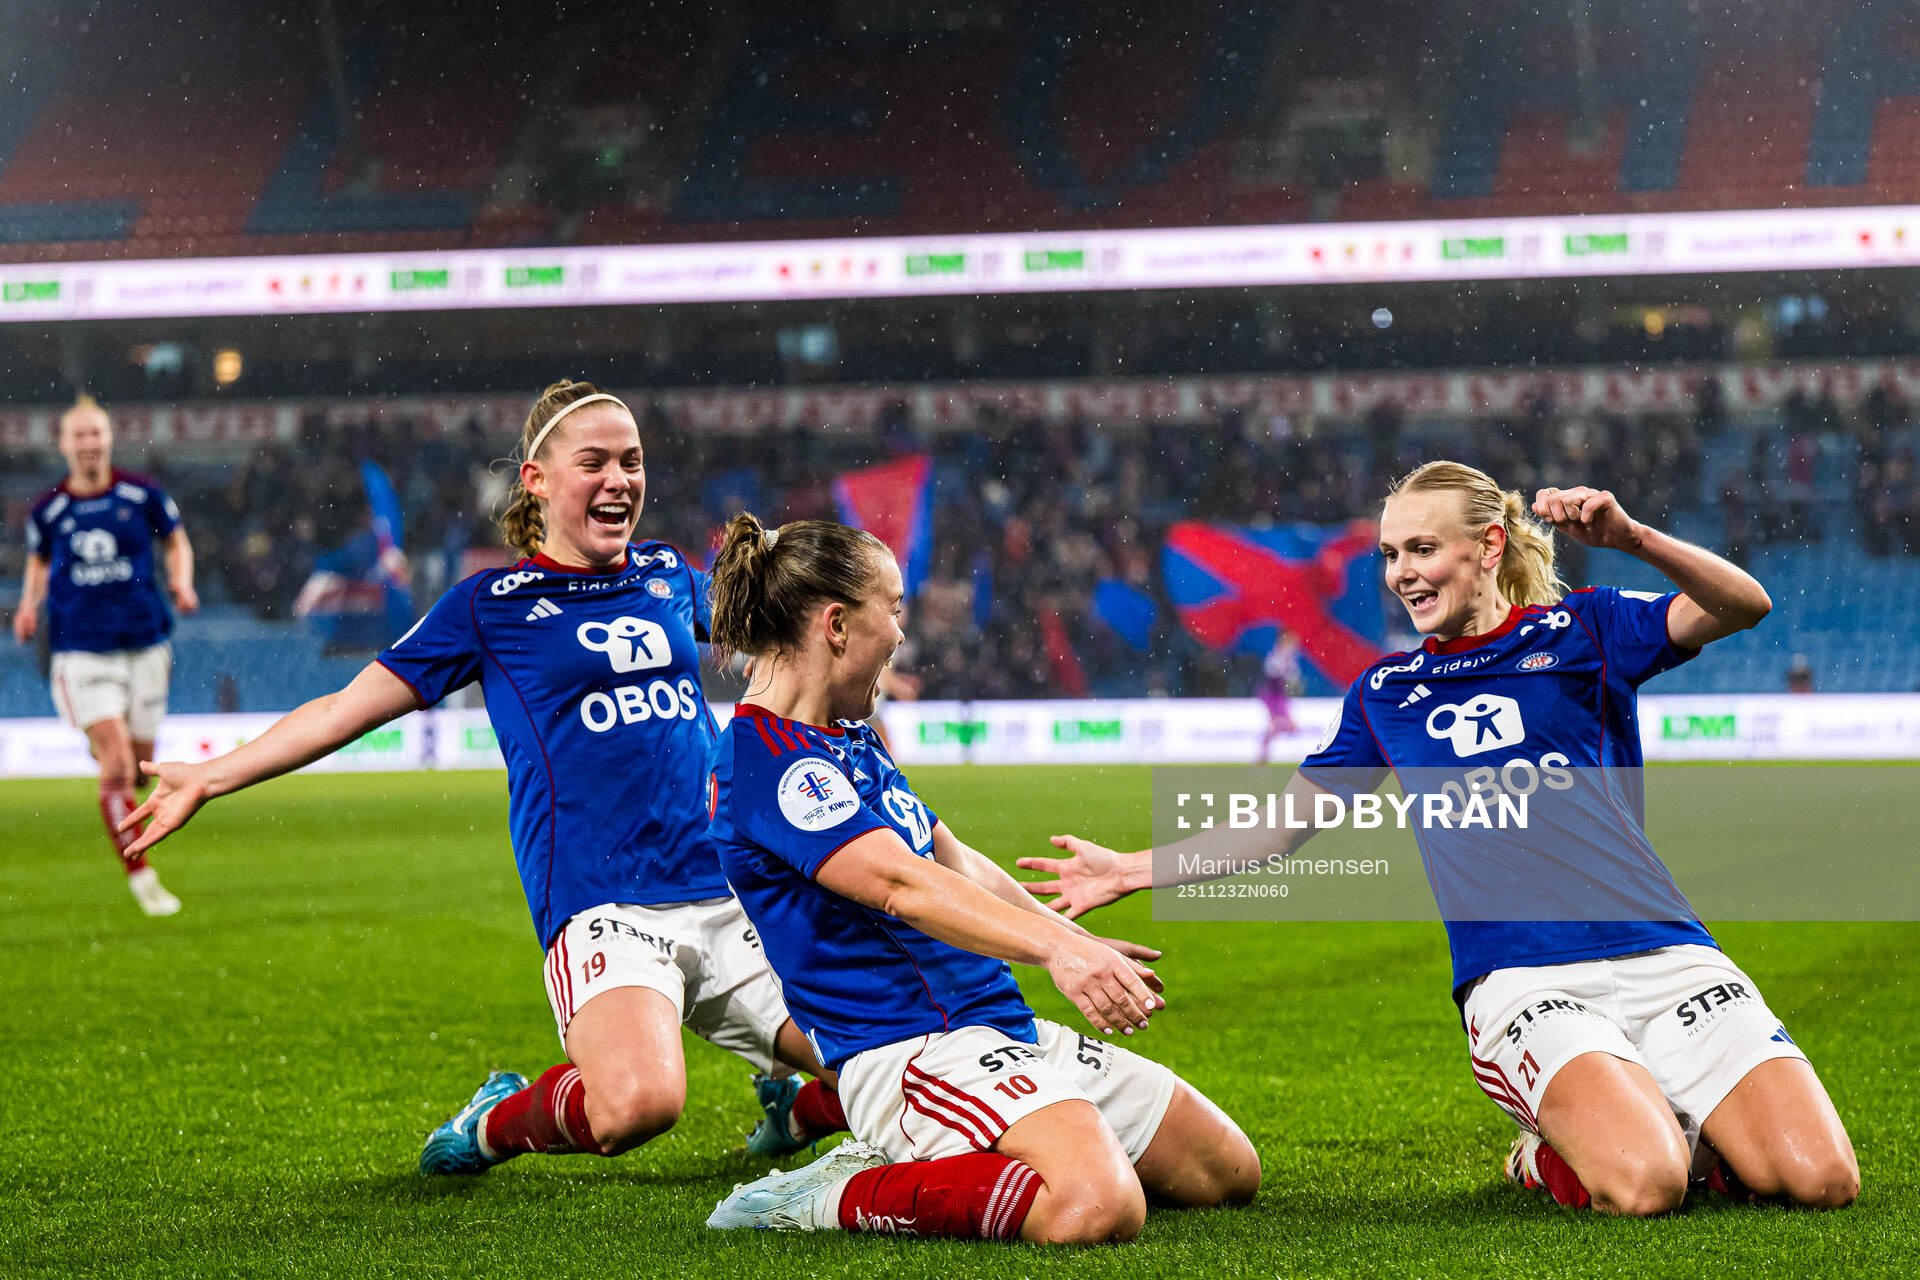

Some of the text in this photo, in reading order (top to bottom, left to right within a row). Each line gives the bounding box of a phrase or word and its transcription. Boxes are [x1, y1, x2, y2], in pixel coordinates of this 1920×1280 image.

[580, 679, 697, 732] OBOS
[1441, 752, 1574, 821] OBOS
[581, 951, 606, 985] 19
[993, 1074, 1039, 1101] 10
[1518, 1049, 1541, 1092] 21
